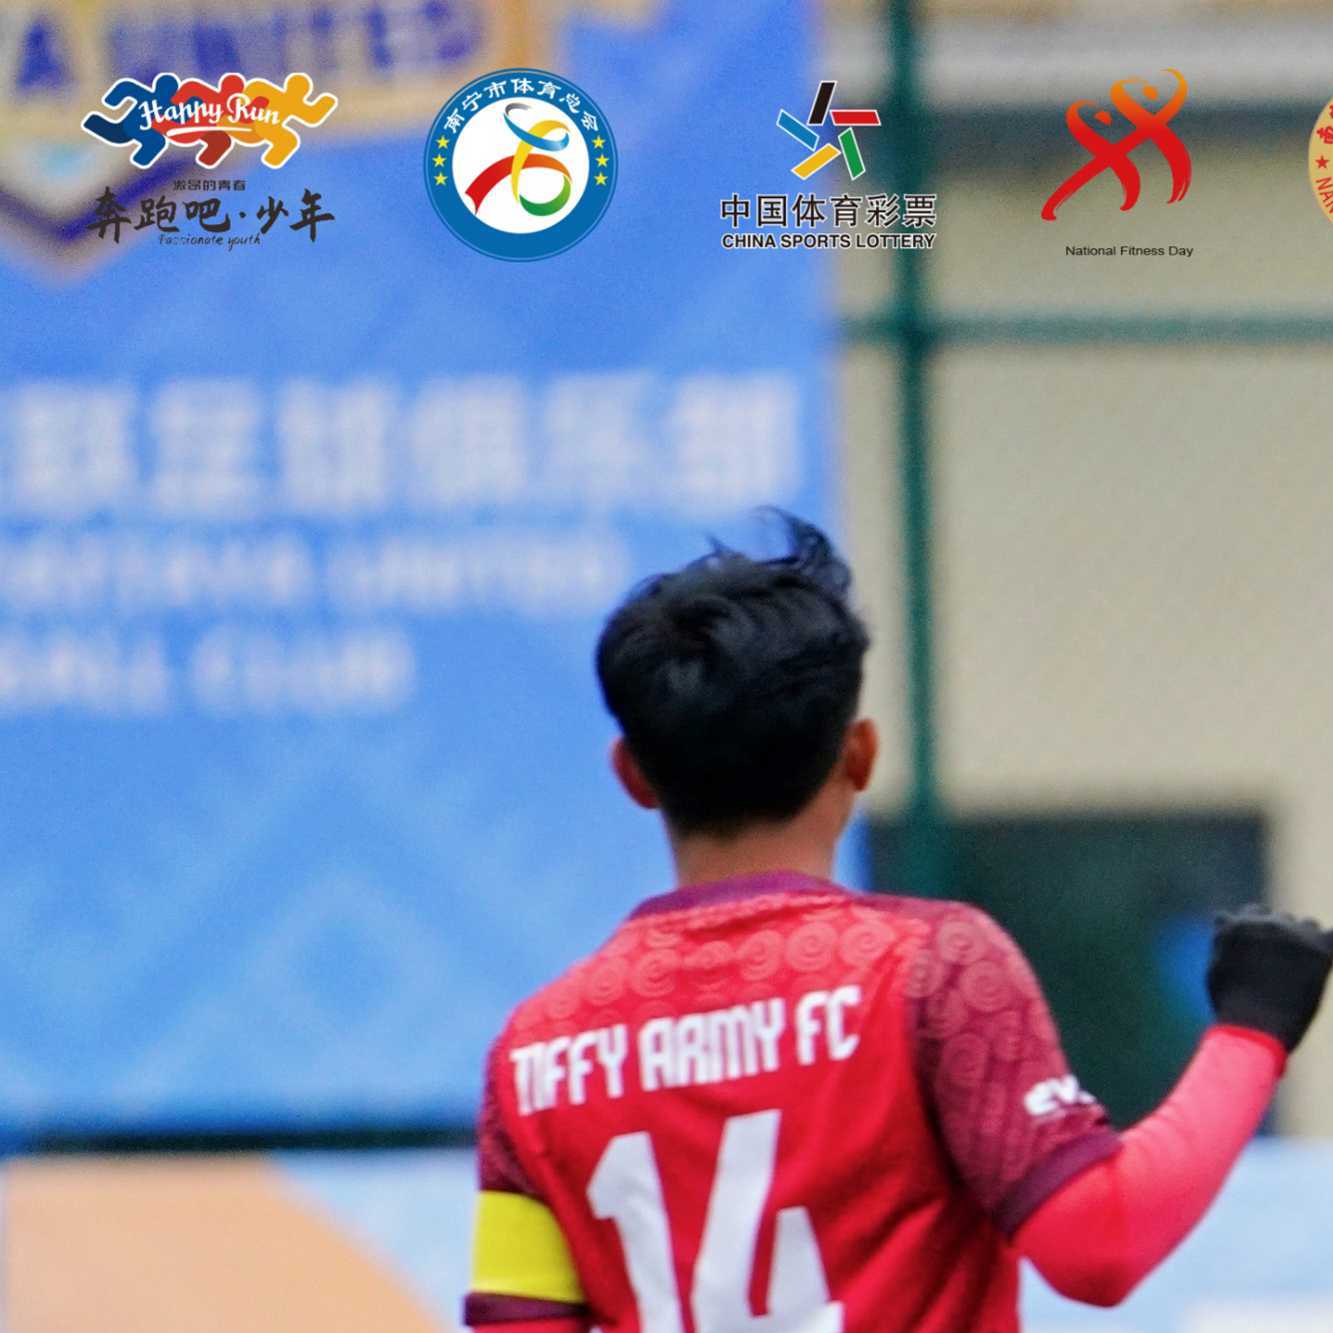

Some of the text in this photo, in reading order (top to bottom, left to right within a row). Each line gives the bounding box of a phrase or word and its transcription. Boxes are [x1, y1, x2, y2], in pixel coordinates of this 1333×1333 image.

[510, 985, 862, 1118] TIFFY ARMY FC
